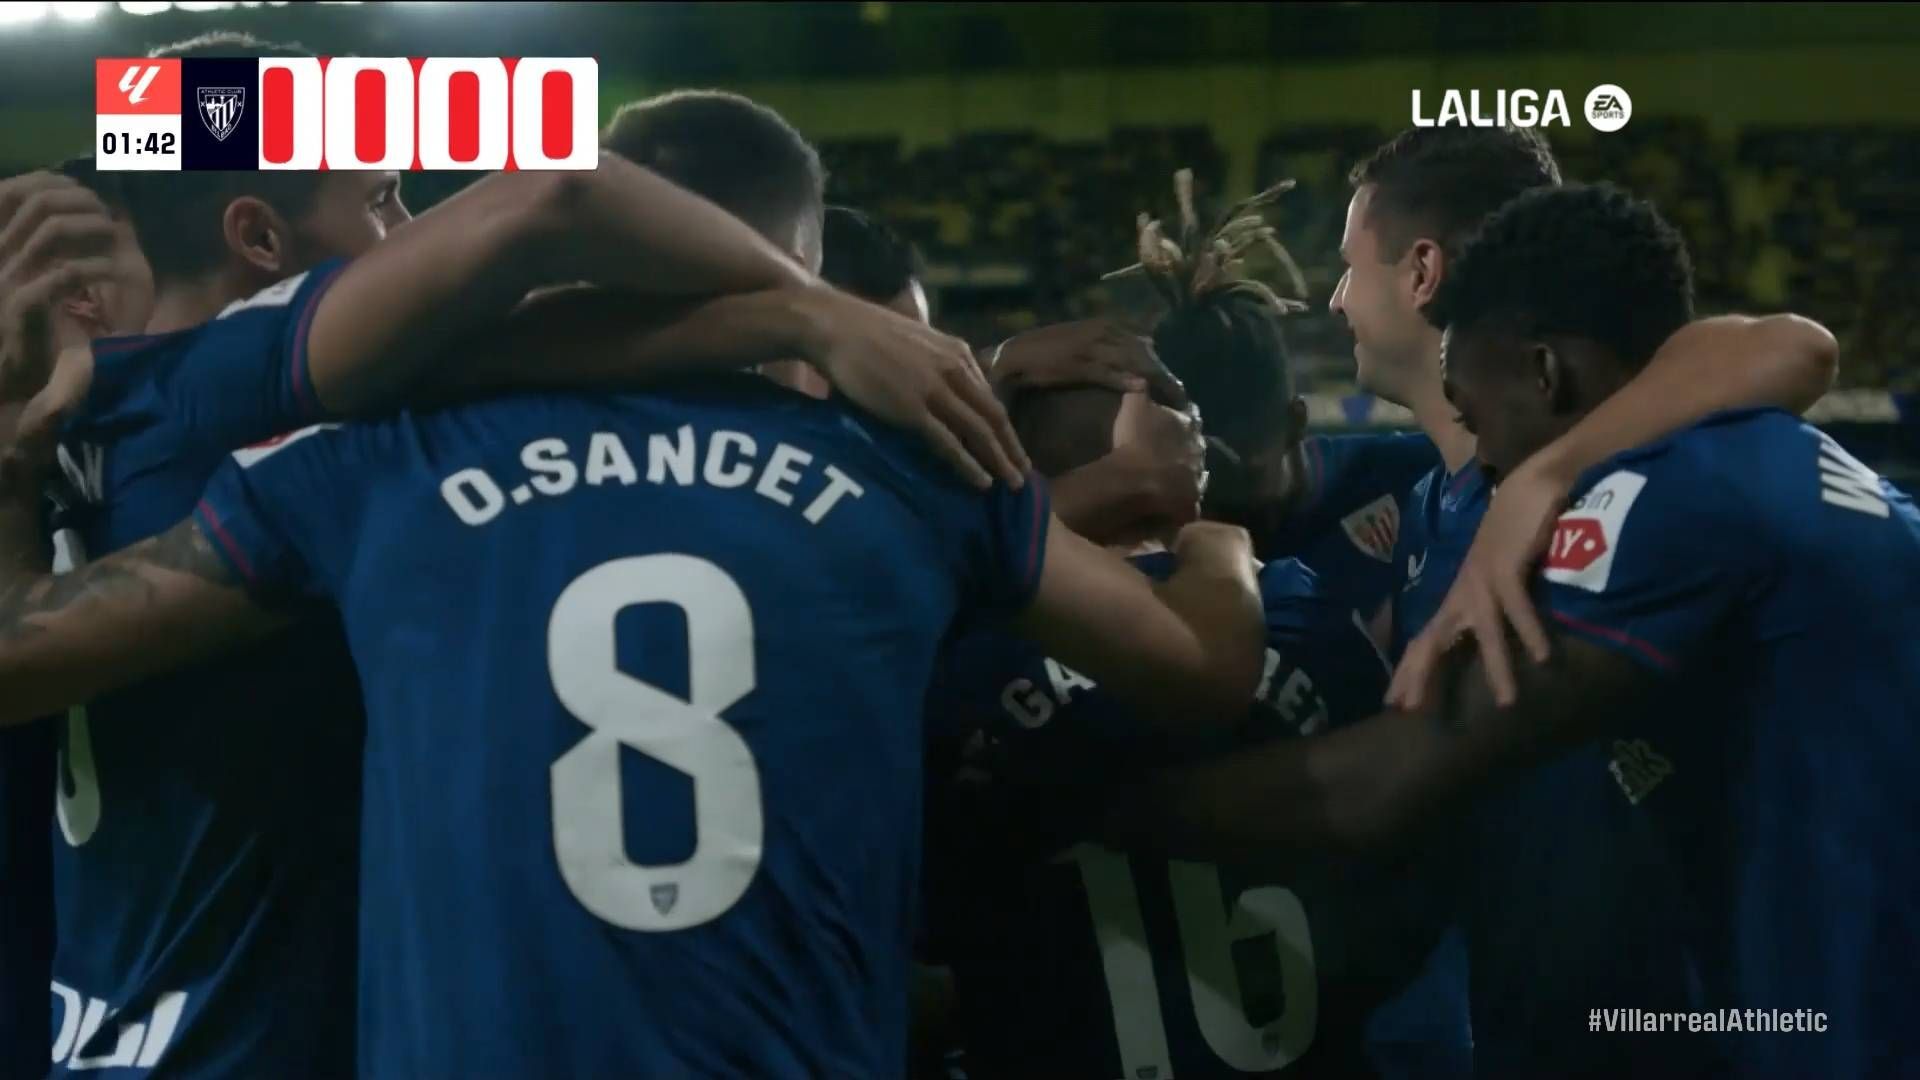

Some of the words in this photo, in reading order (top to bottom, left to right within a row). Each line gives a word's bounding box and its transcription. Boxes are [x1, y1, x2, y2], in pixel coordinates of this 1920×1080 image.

[441, 425, 864, 525] O.SANCET
[547, 552, 763, 932] 8
[1050, 842, 1318, 1080] 16
